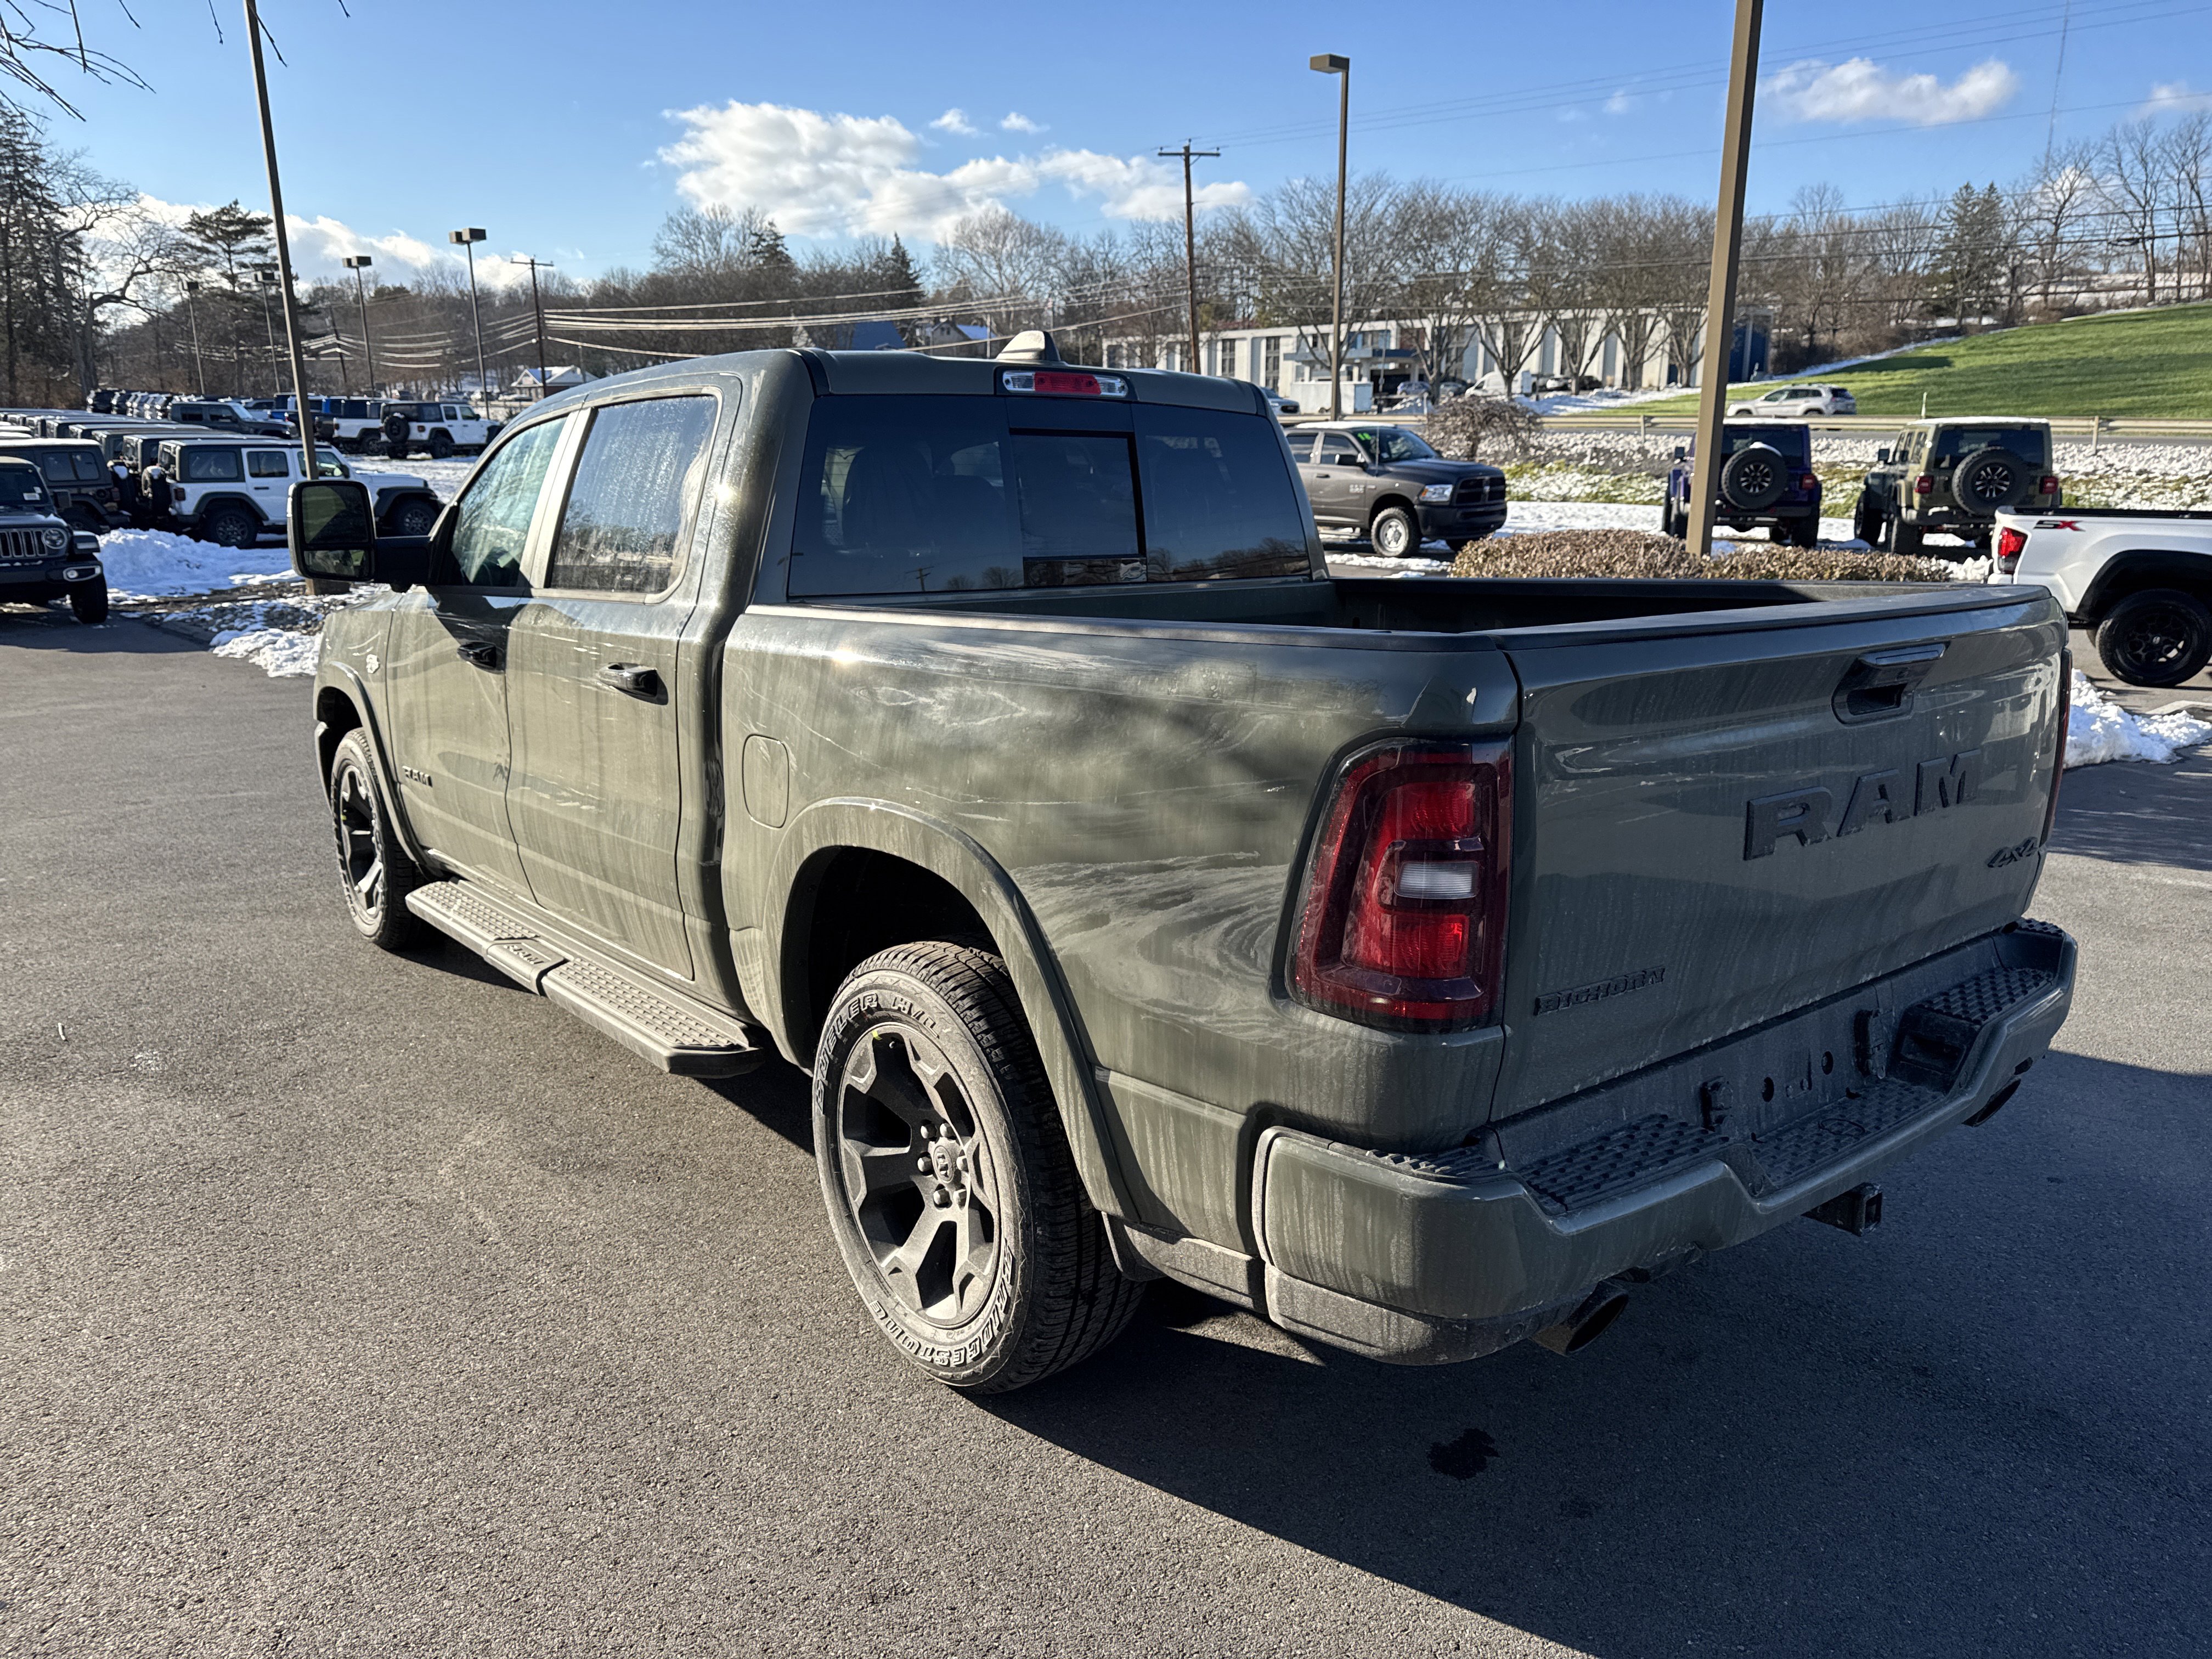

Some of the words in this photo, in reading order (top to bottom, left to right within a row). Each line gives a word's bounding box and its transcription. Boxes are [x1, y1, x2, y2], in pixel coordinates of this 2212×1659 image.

[402, 765, 433, 787] RAM
[1743, 749, 1980, 861] RAM
[816, 992, 883, 1115] DUELER
[869, 1237, 1018, 1368] BRIDGESTONE
